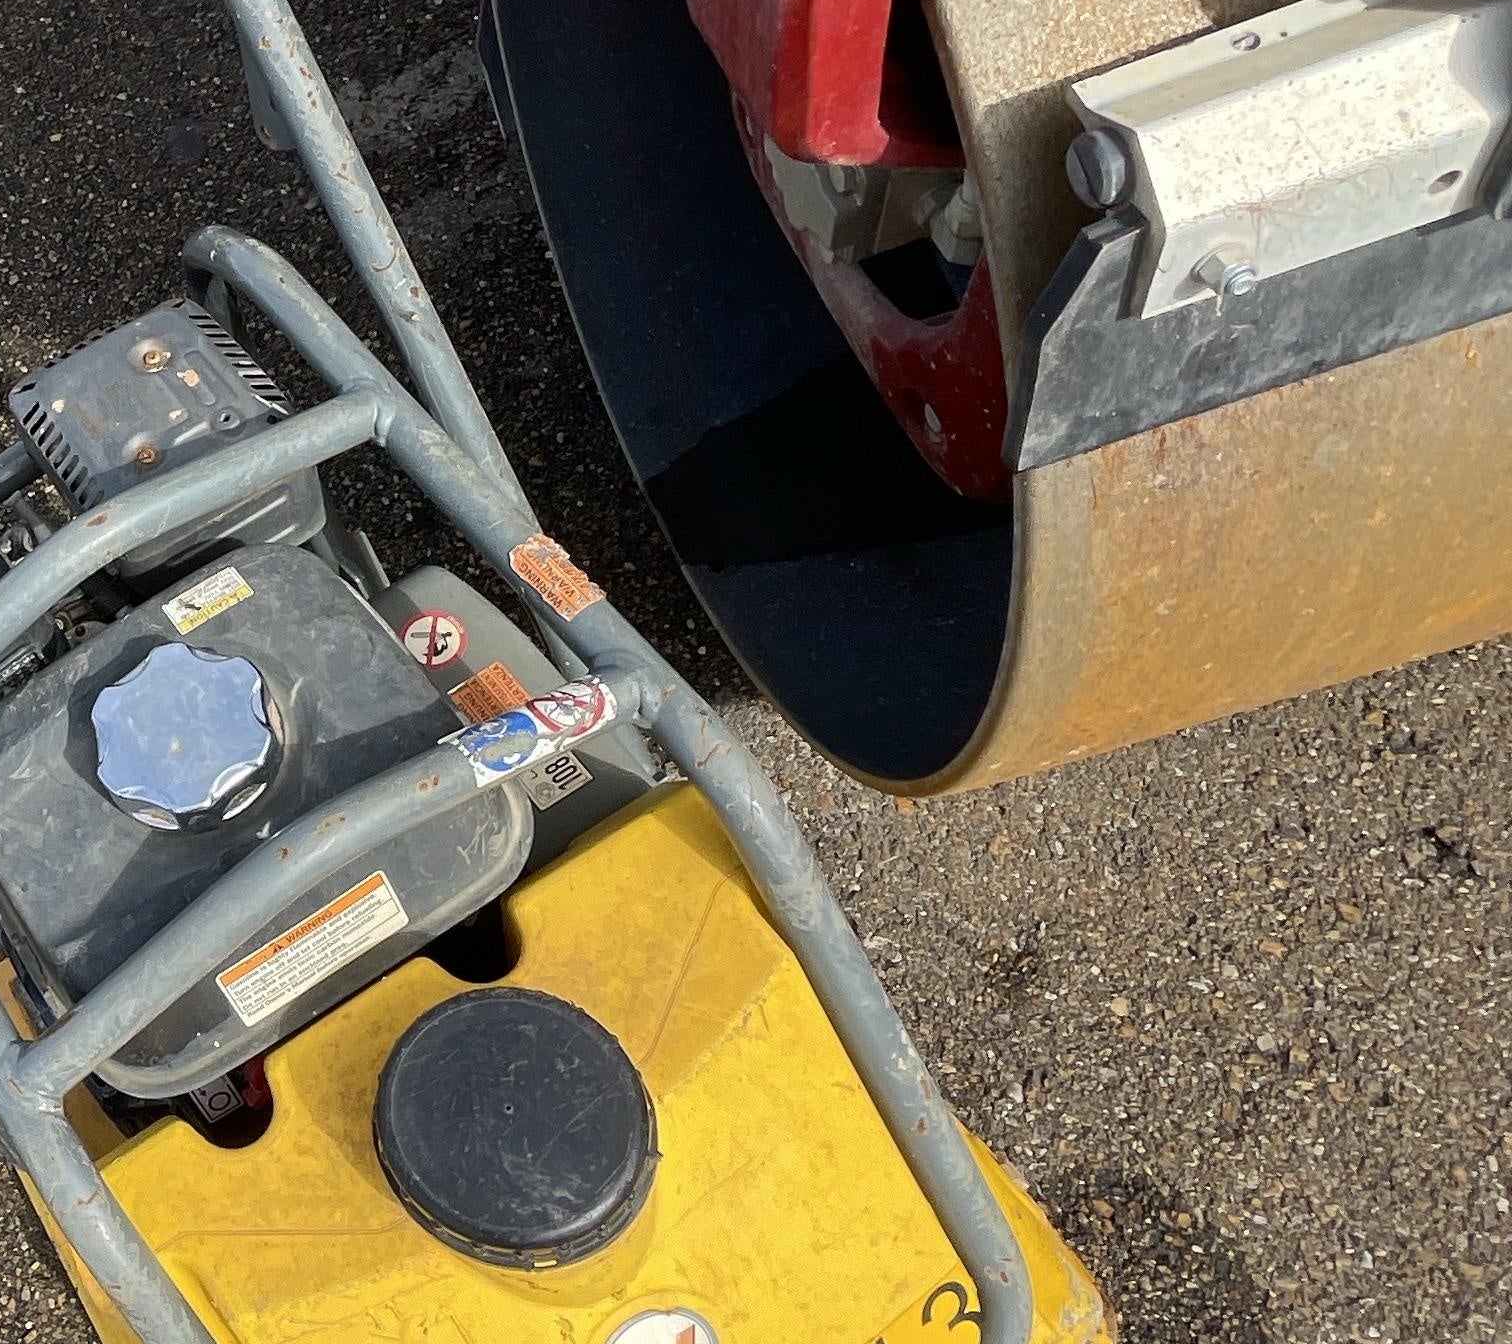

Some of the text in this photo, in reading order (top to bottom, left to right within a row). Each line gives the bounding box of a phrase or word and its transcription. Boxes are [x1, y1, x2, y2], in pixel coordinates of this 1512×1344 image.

[518, 561, 562, 609] WARNING
[544, 756, 582, 789] 108
[284, 909, 333, 944] WARNING
